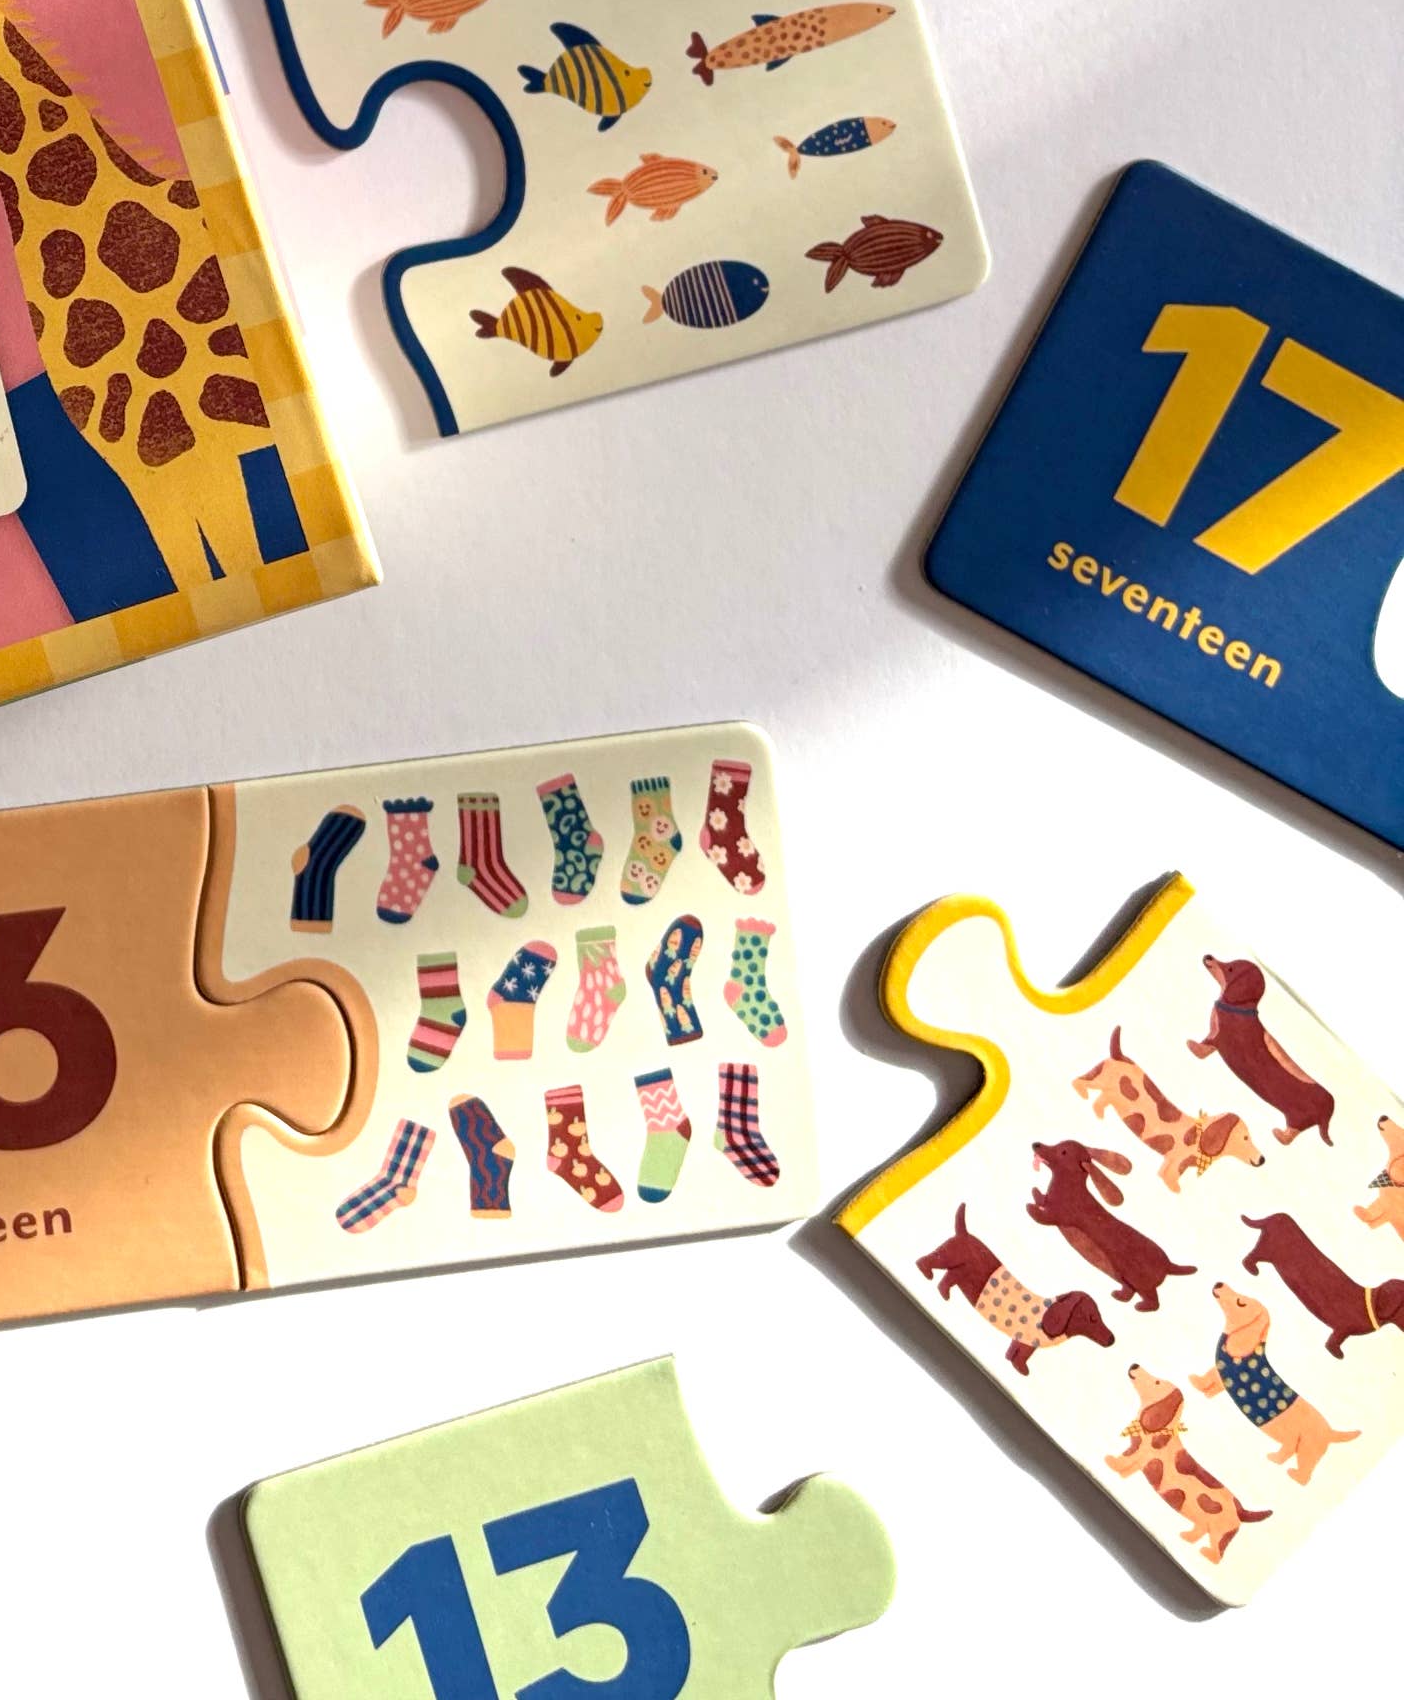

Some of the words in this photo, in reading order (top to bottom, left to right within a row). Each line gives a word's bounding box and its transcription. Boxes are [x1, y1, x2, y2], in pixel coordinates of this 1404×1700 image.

[1113, 303, 1404, 575] 17
[1046, 538, 1284, 691] seventeen
[360, 1478, 693, 1700] 13
